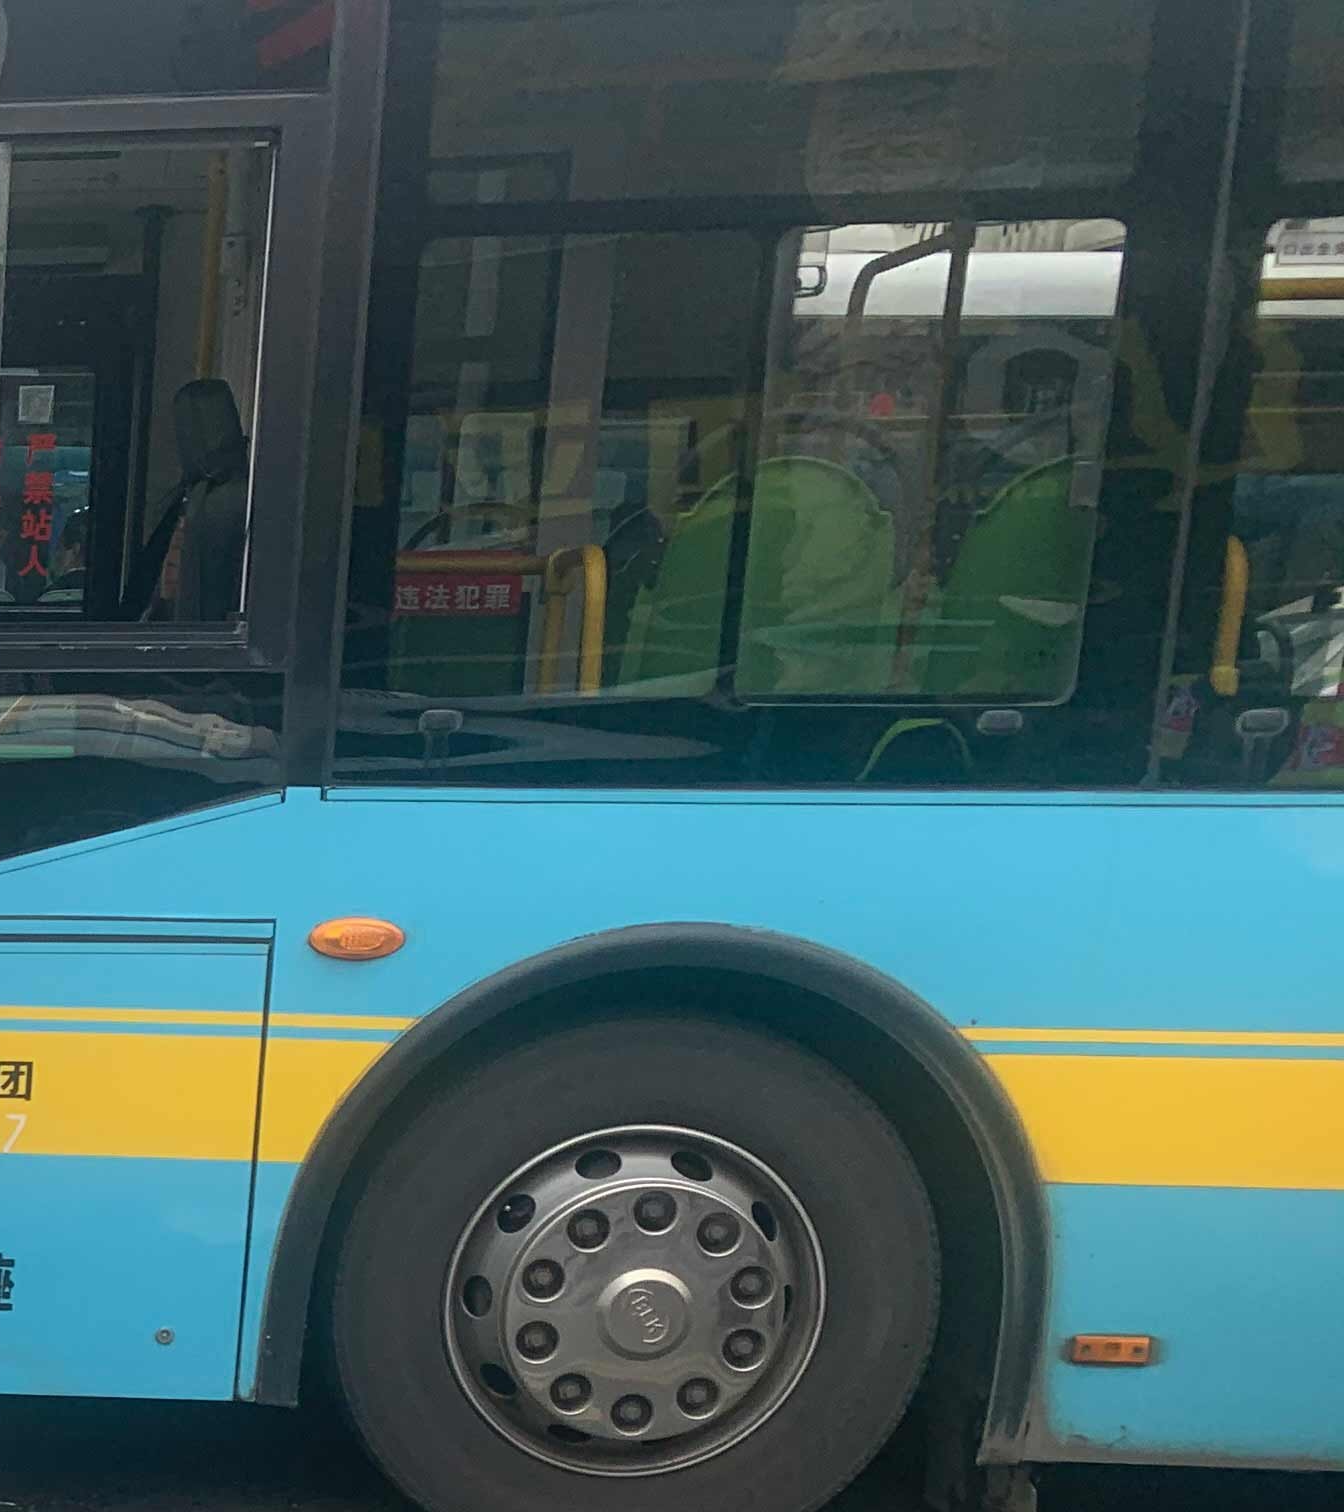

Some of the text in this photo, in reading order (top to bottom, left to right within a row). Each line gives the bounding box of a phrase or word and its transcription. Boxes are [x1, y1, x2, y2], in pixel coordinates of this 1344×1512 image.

[18, 433, 57, 577] 严禁站人
[395, 584, 511, 610] 违法犯罪
